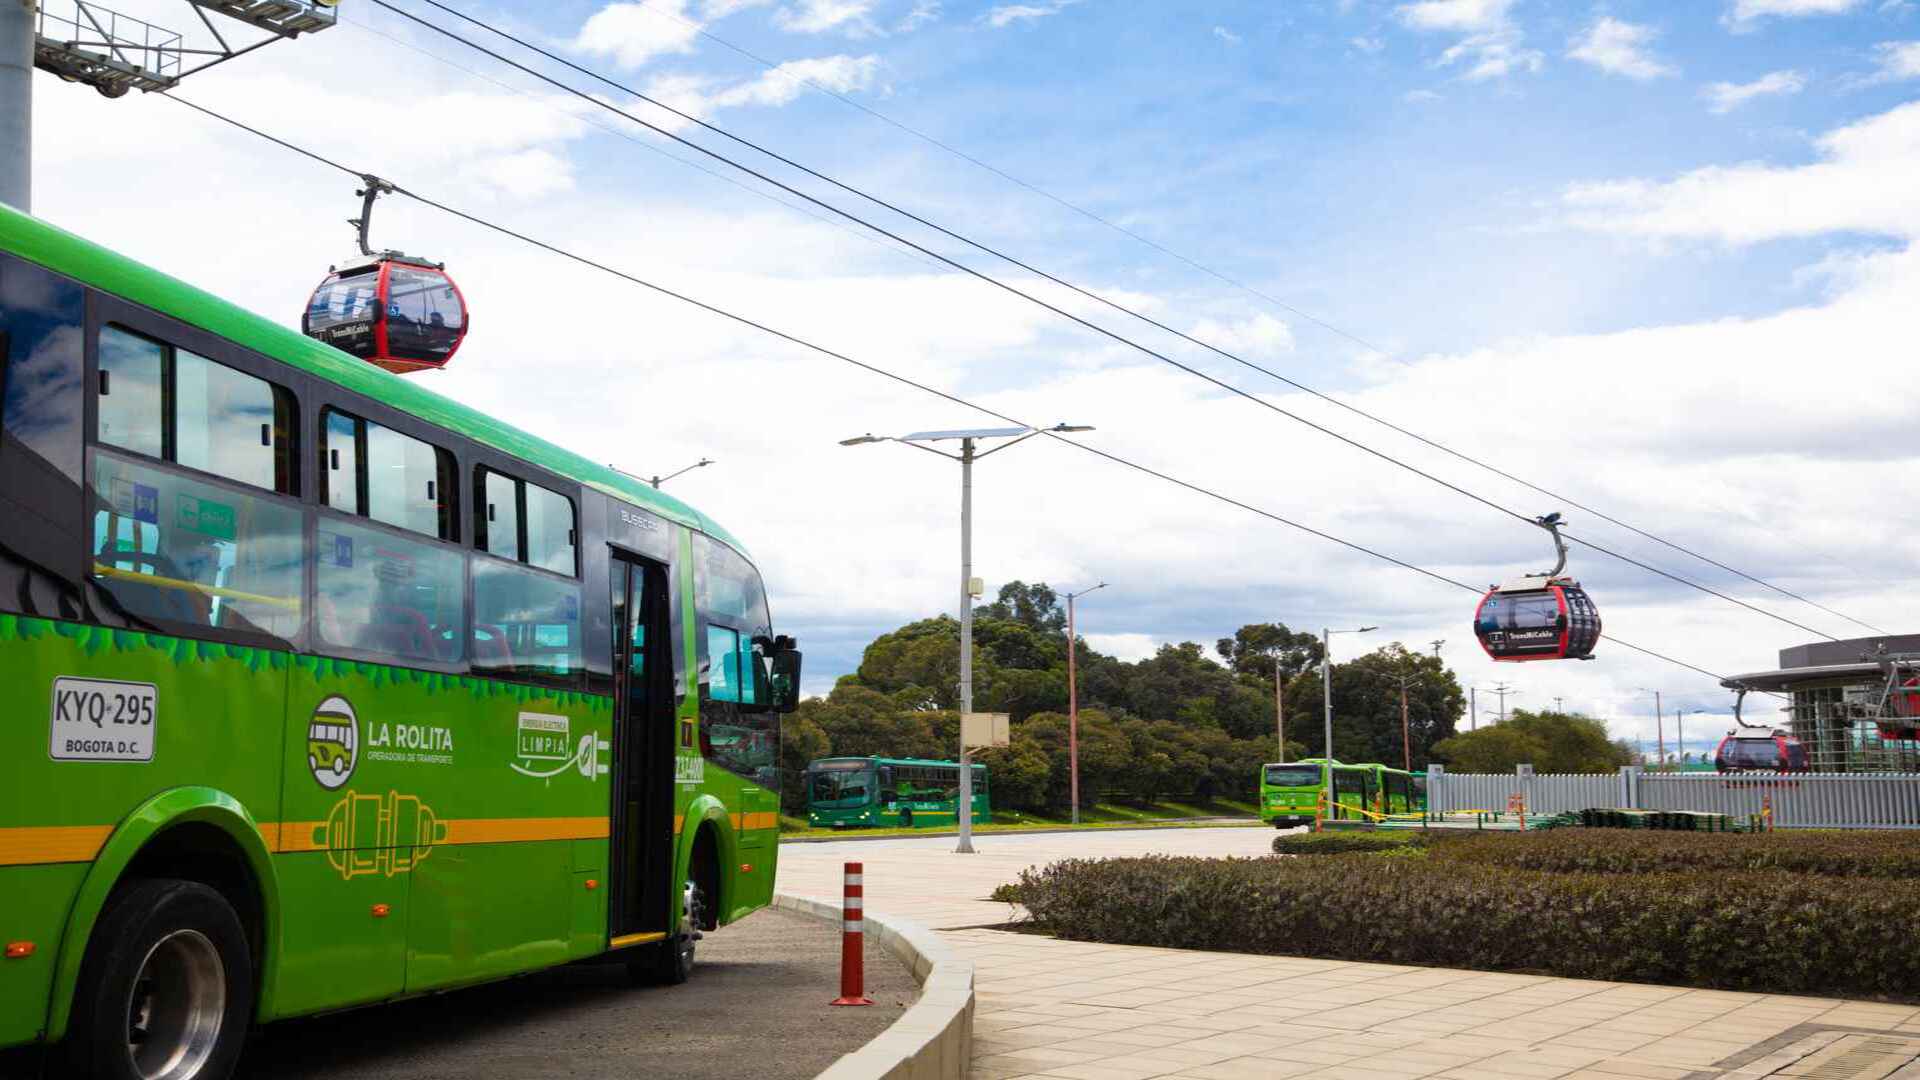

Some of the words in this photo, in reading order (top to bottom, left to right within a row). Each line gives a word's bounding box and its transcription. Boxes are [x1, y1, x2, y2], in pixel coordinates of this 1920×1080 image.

[66, 740, 114, 753] BOGOTA
[368, 721, 391, 747] LA
[396, 724, 453, 752] ROLITA
[522, 735, 567, 755] LIMPIA
